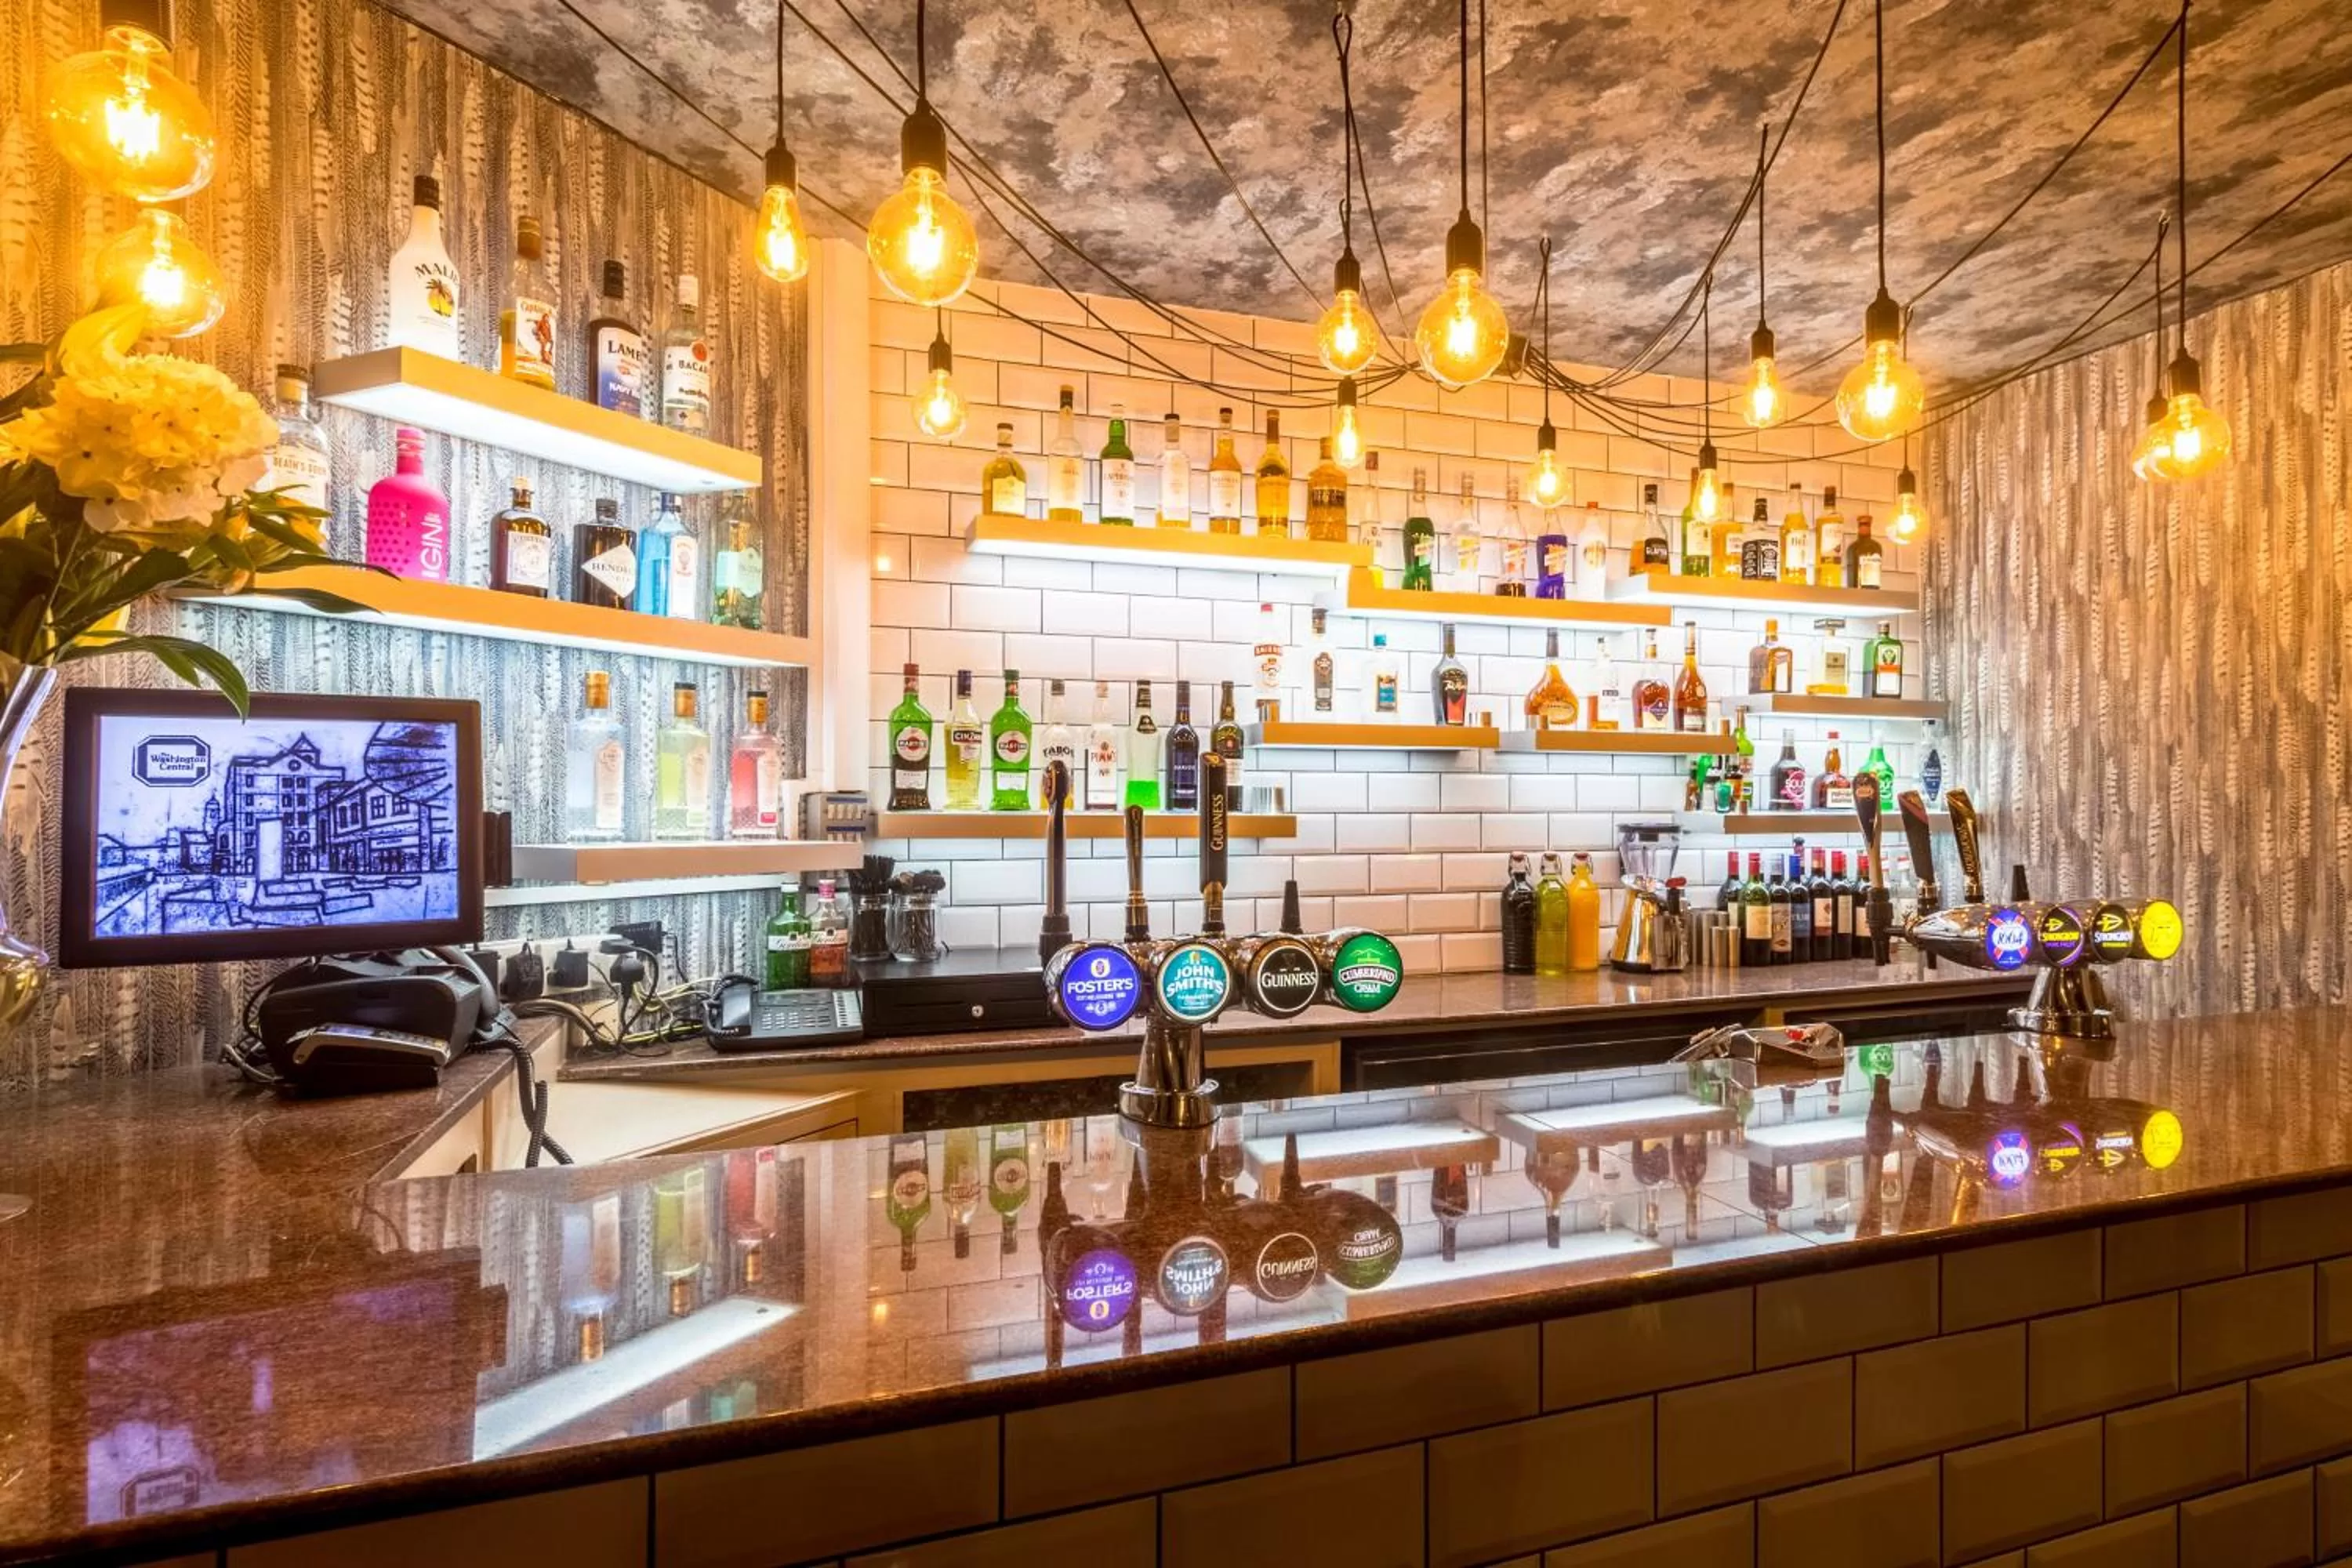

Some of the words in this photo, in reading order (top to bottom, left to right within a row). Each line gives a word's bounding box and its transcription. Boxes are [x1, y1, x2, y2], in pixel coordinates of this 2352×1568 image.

[151, 754, 206, 764] Washington
[1210, 793, 1224, 851] GUINNESS
[1174, 964, 1215, 981] JOHN
[1261, 971, 1316, 988] GUINNESS
[1067, 978, 1134, 995] FOSTER'S
[1166, 977, 1224, 997] SMITH'S
